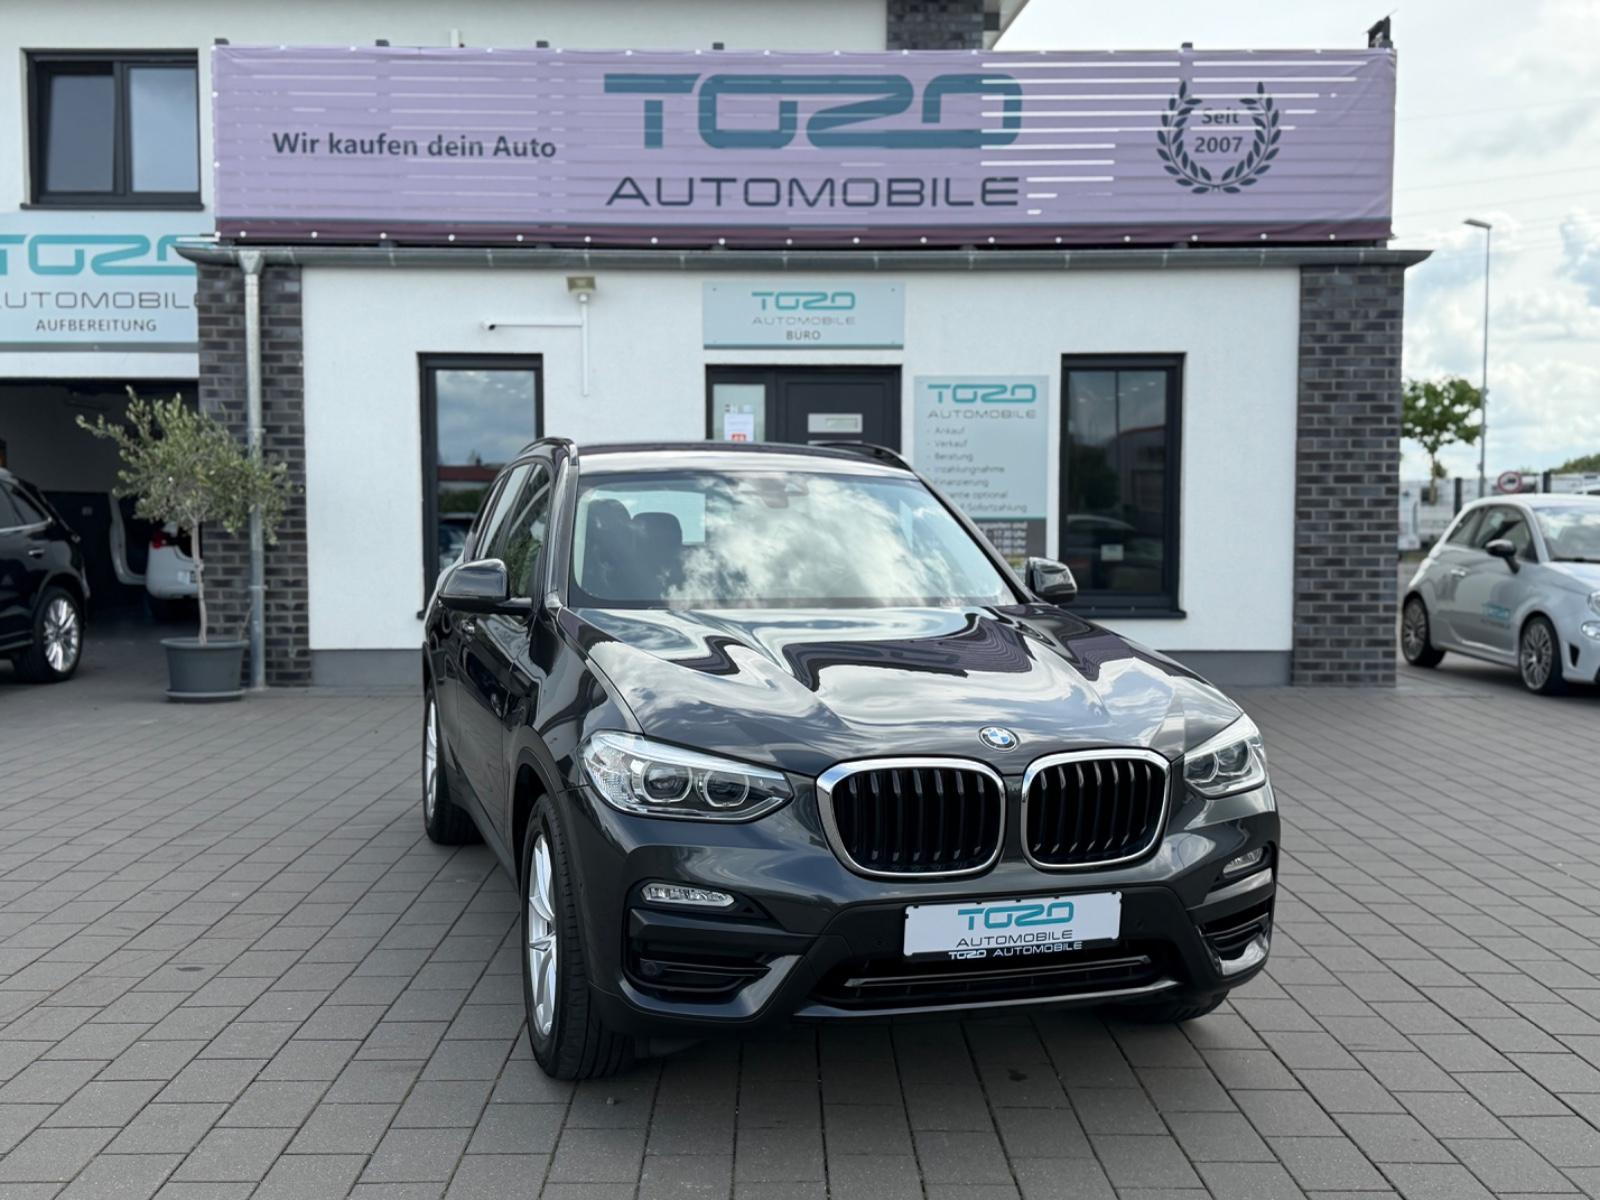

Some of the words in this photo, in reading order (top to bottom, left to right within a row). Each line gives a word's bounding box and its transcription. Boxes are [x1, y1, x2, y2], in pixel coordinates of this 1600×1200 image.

[604, 73, 1023, 149] TOZO
[1201, 106, 1240, 125] Seit
[272, 132, 320, 153] Wir
[328, 132, 418, 156] kaufen
[427, 134, 484, 157] dein
[492, 136, 557, 158] Auto
[1194, 136, 1243, 153] 2007
[605, 177, 1018, 207] AUTOMOBILE
[0, 291, 200, 309] UTOMOBIL
[751, 291, 856, 311] TOZO
[36, 318, 157, 332] AUFBEREITUNG
[752, 316, 856, 327] AUTOMOBILE
[927, 383, 1037, 404] TOZO
[927, 409, 1037, 419] AUTOMOBILE
[934, 452, 974, 462] Beratung
[957, 901, 1074, 931] TOZO
[956, 929, 1073, 948] AUTOMOBILE
[948, 949, 987, 960] TOZO
[992, 941, 1083, 958] AUTOMOBILE
